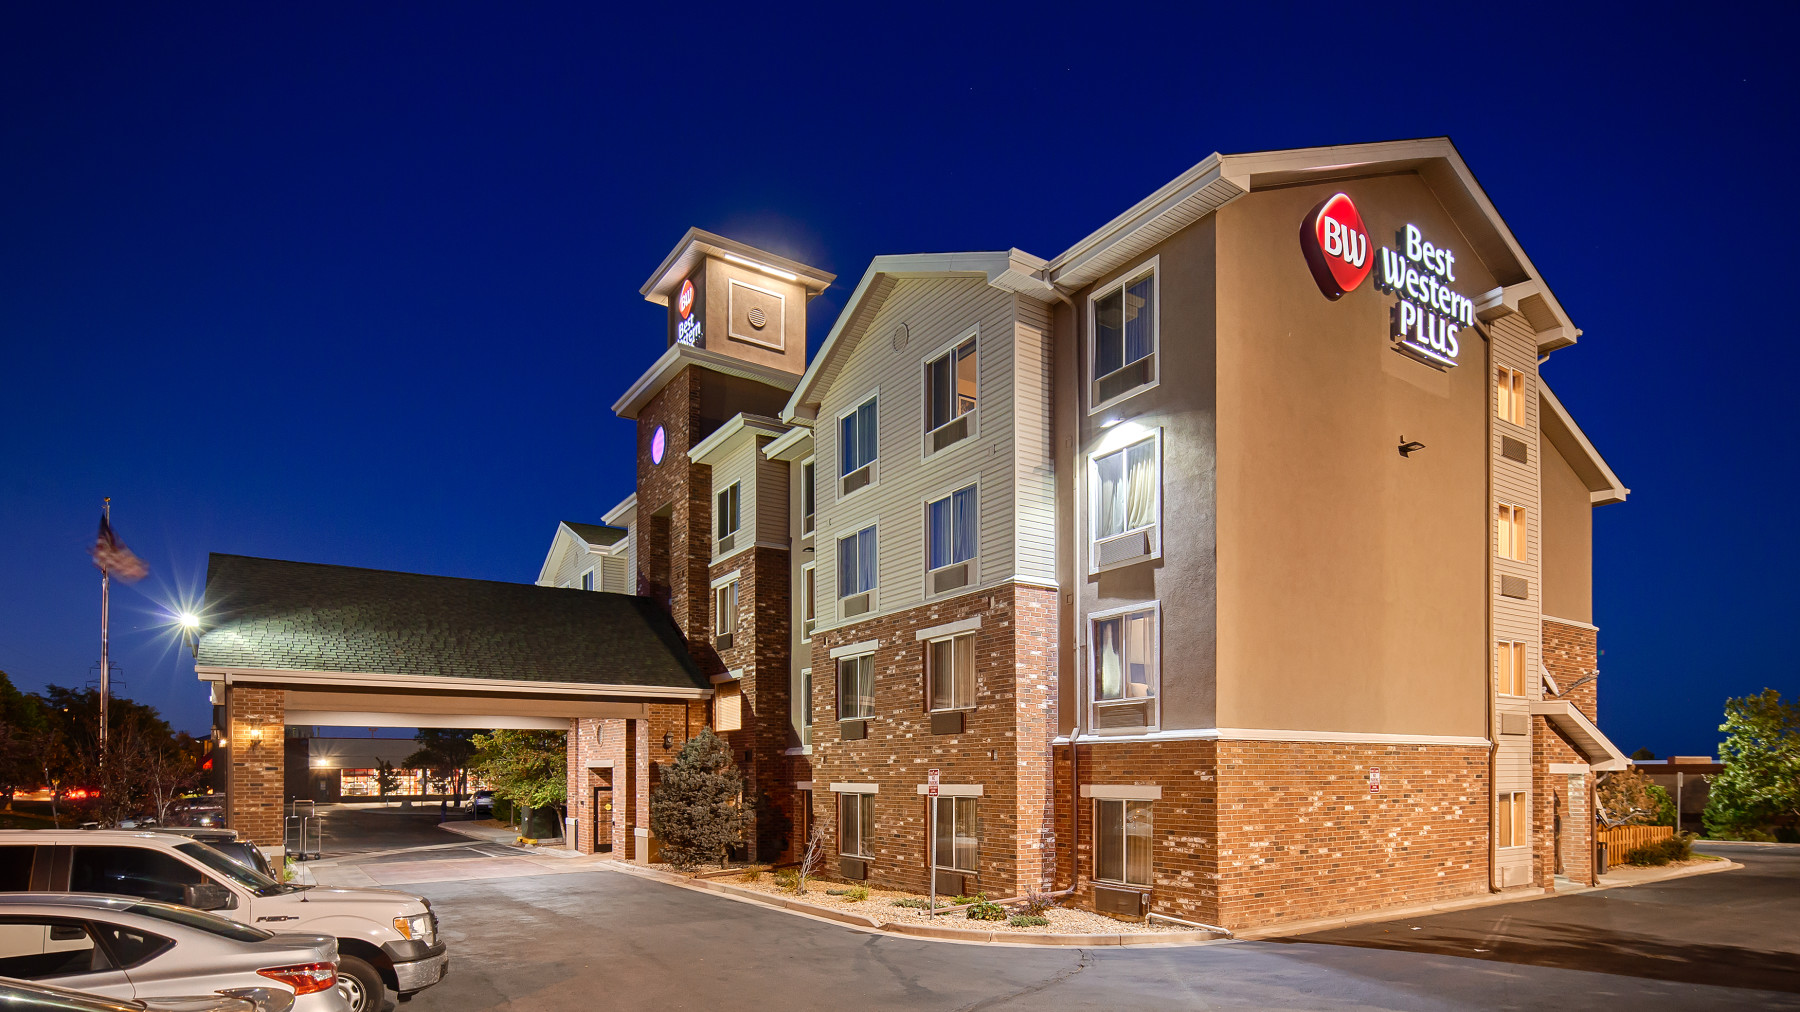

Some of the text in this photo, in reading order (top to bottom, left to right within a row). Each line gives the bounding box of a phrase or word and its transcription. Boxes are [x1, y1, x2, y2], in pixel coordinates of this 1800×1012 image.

[1324, 216, 1367, 268] BW
[1406, 223, 1456, 282] Best
[681, 287, 692, 312] BW
[1382, 246, 1474, 327] Western
[678, 313, 694, 339] Best
[1400, 299, 1459, 358] PLUS
